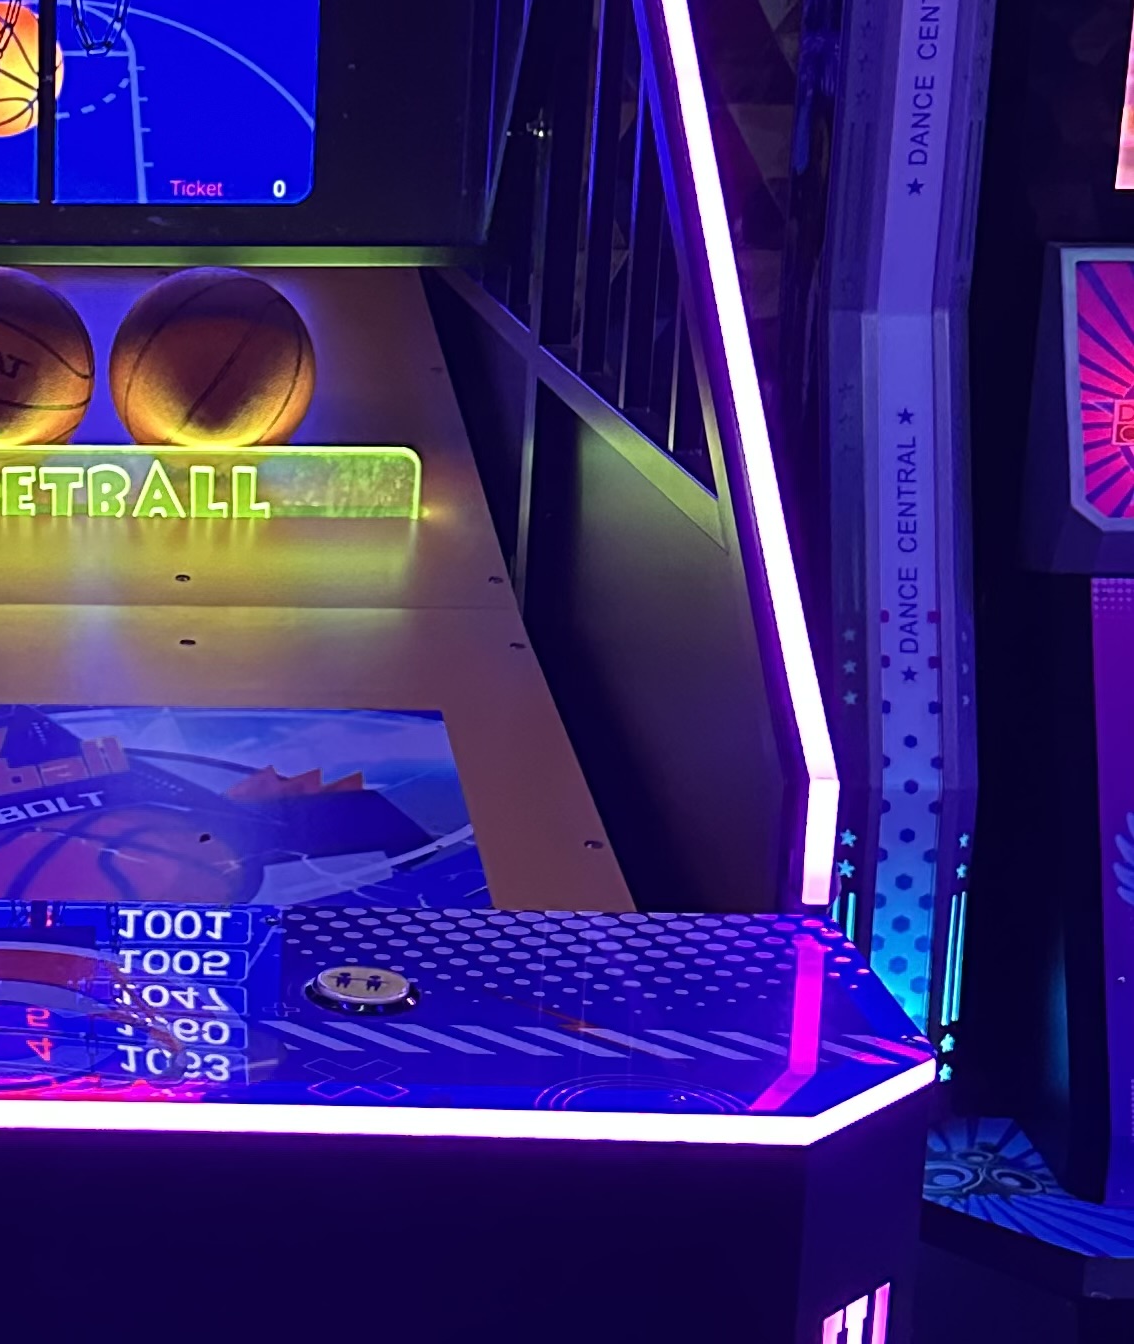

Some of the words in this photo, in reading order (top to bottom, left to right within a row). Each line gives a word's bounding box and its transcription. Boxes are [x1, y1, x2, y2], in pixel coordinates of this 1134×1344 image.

[908, 74, 935, 167] DANCE
[169, 179, 224, 198] Ticket
[272, 179, 287, 198] 0
[896, 435, 918, 553] CENTRAL
[898, 566, 919, 655] DANCE
